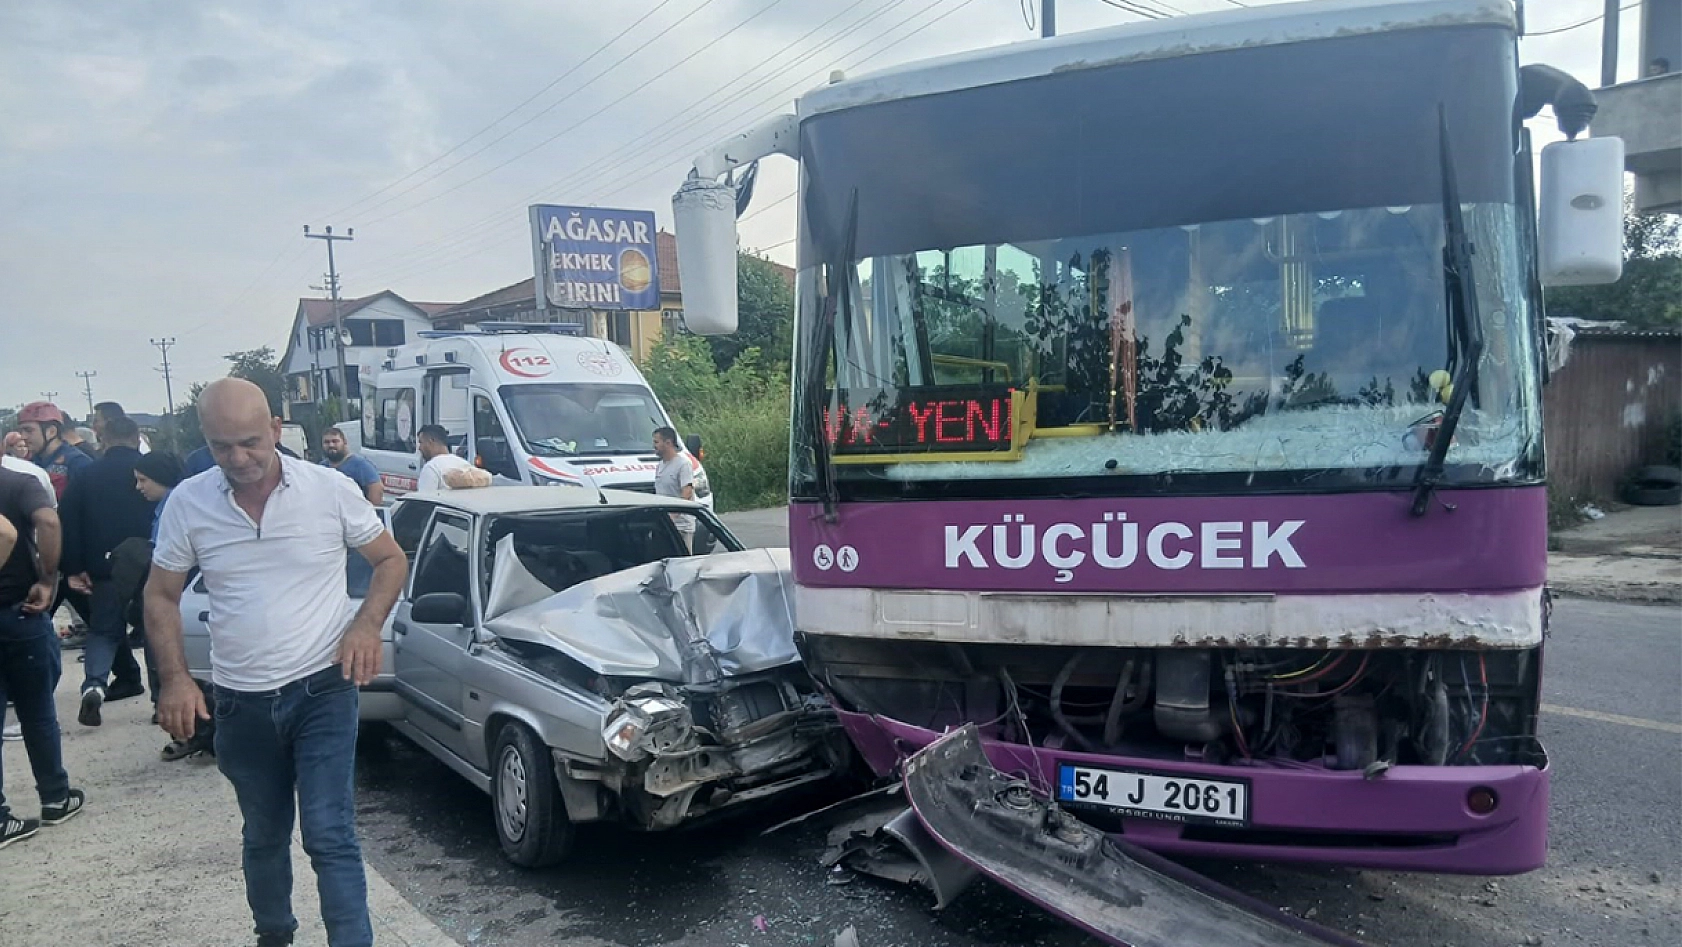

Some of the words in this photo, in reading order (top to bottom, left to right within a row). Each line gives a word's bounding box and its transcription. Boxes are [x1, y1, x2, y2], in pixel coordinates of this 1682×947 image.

[546, 211, 650, 244] AĞASAR
[552, 252, 614, 271] EKMEK
[553, 281, 620, 303] FIRINI
[510, 356, 550, 367] 112
[944, 511, 1307, 582] KÜÇÜCEK
[1061, 785, 1072, 794] TR
[1075, 771, 1109, 800] 54
[1127, 778, 1145, 804] J
[1163, 781, 1237, 815] 2061
